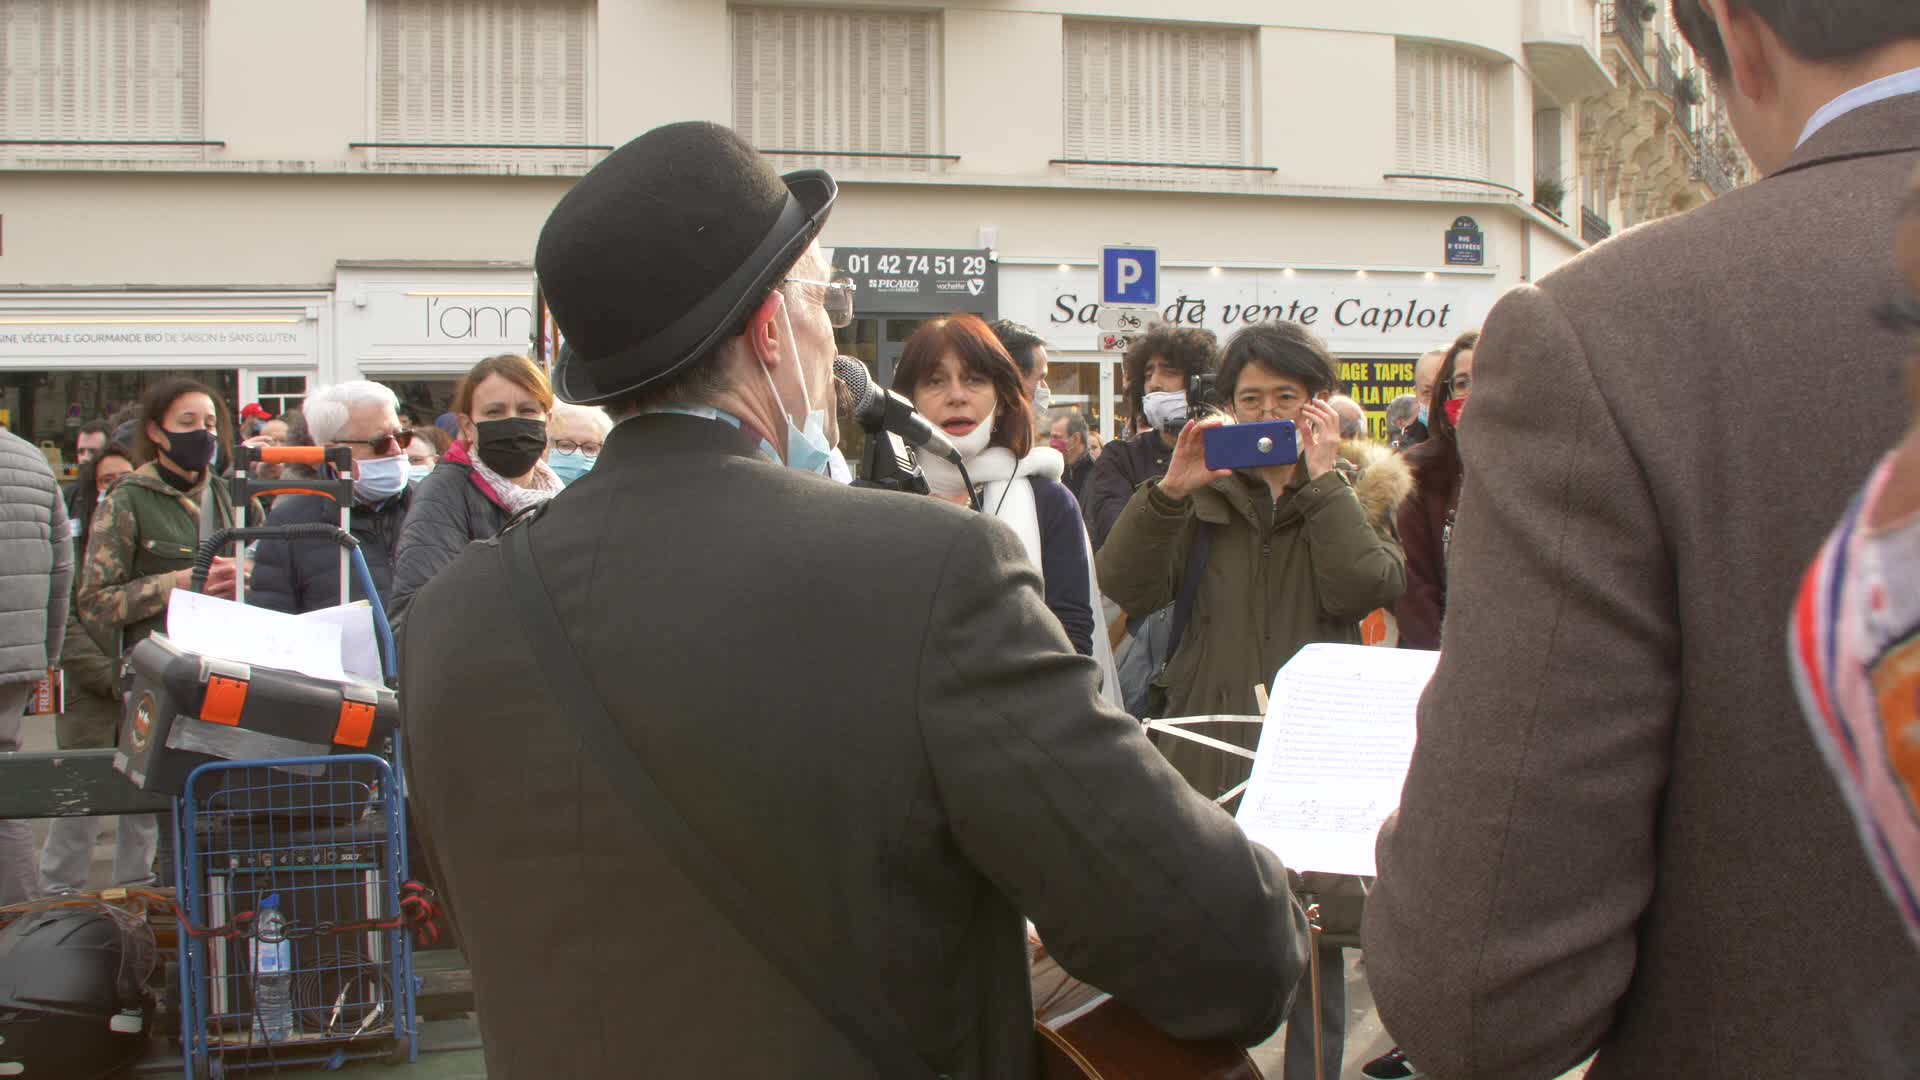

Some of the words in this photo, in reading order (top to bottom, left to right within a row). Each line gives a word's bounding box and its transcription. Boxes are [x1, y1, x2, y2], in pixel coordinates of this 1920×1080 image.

[848, 254, 870, 273] 01
[877, 255, 900, 274] 42
[906, 256, 929, 274] 74
[934, 256, 955, 275] 51
[962, 256, 986, 275] 29
[878, 279, 919, 288] PICARD
[1117, 257, 1143, 294] P
[1163, 295, 1206, 325] de
[1222, 299, 1318, 325] vente
[1334, 298, 1452, 333] Caplot
[0, 333, 17, 343] INE
[74, 333, 142, 343] GOURMANDE
[145, 333, 162, 343] BIO
[229, 332, 254, 342] SANS
[256, 332, 297, 342] GLUTEN
[1373, 363, 1413, 381] TAPIS
[1351, 383, 1361, 404] À
[1363, 386, 1380, 405] LA
